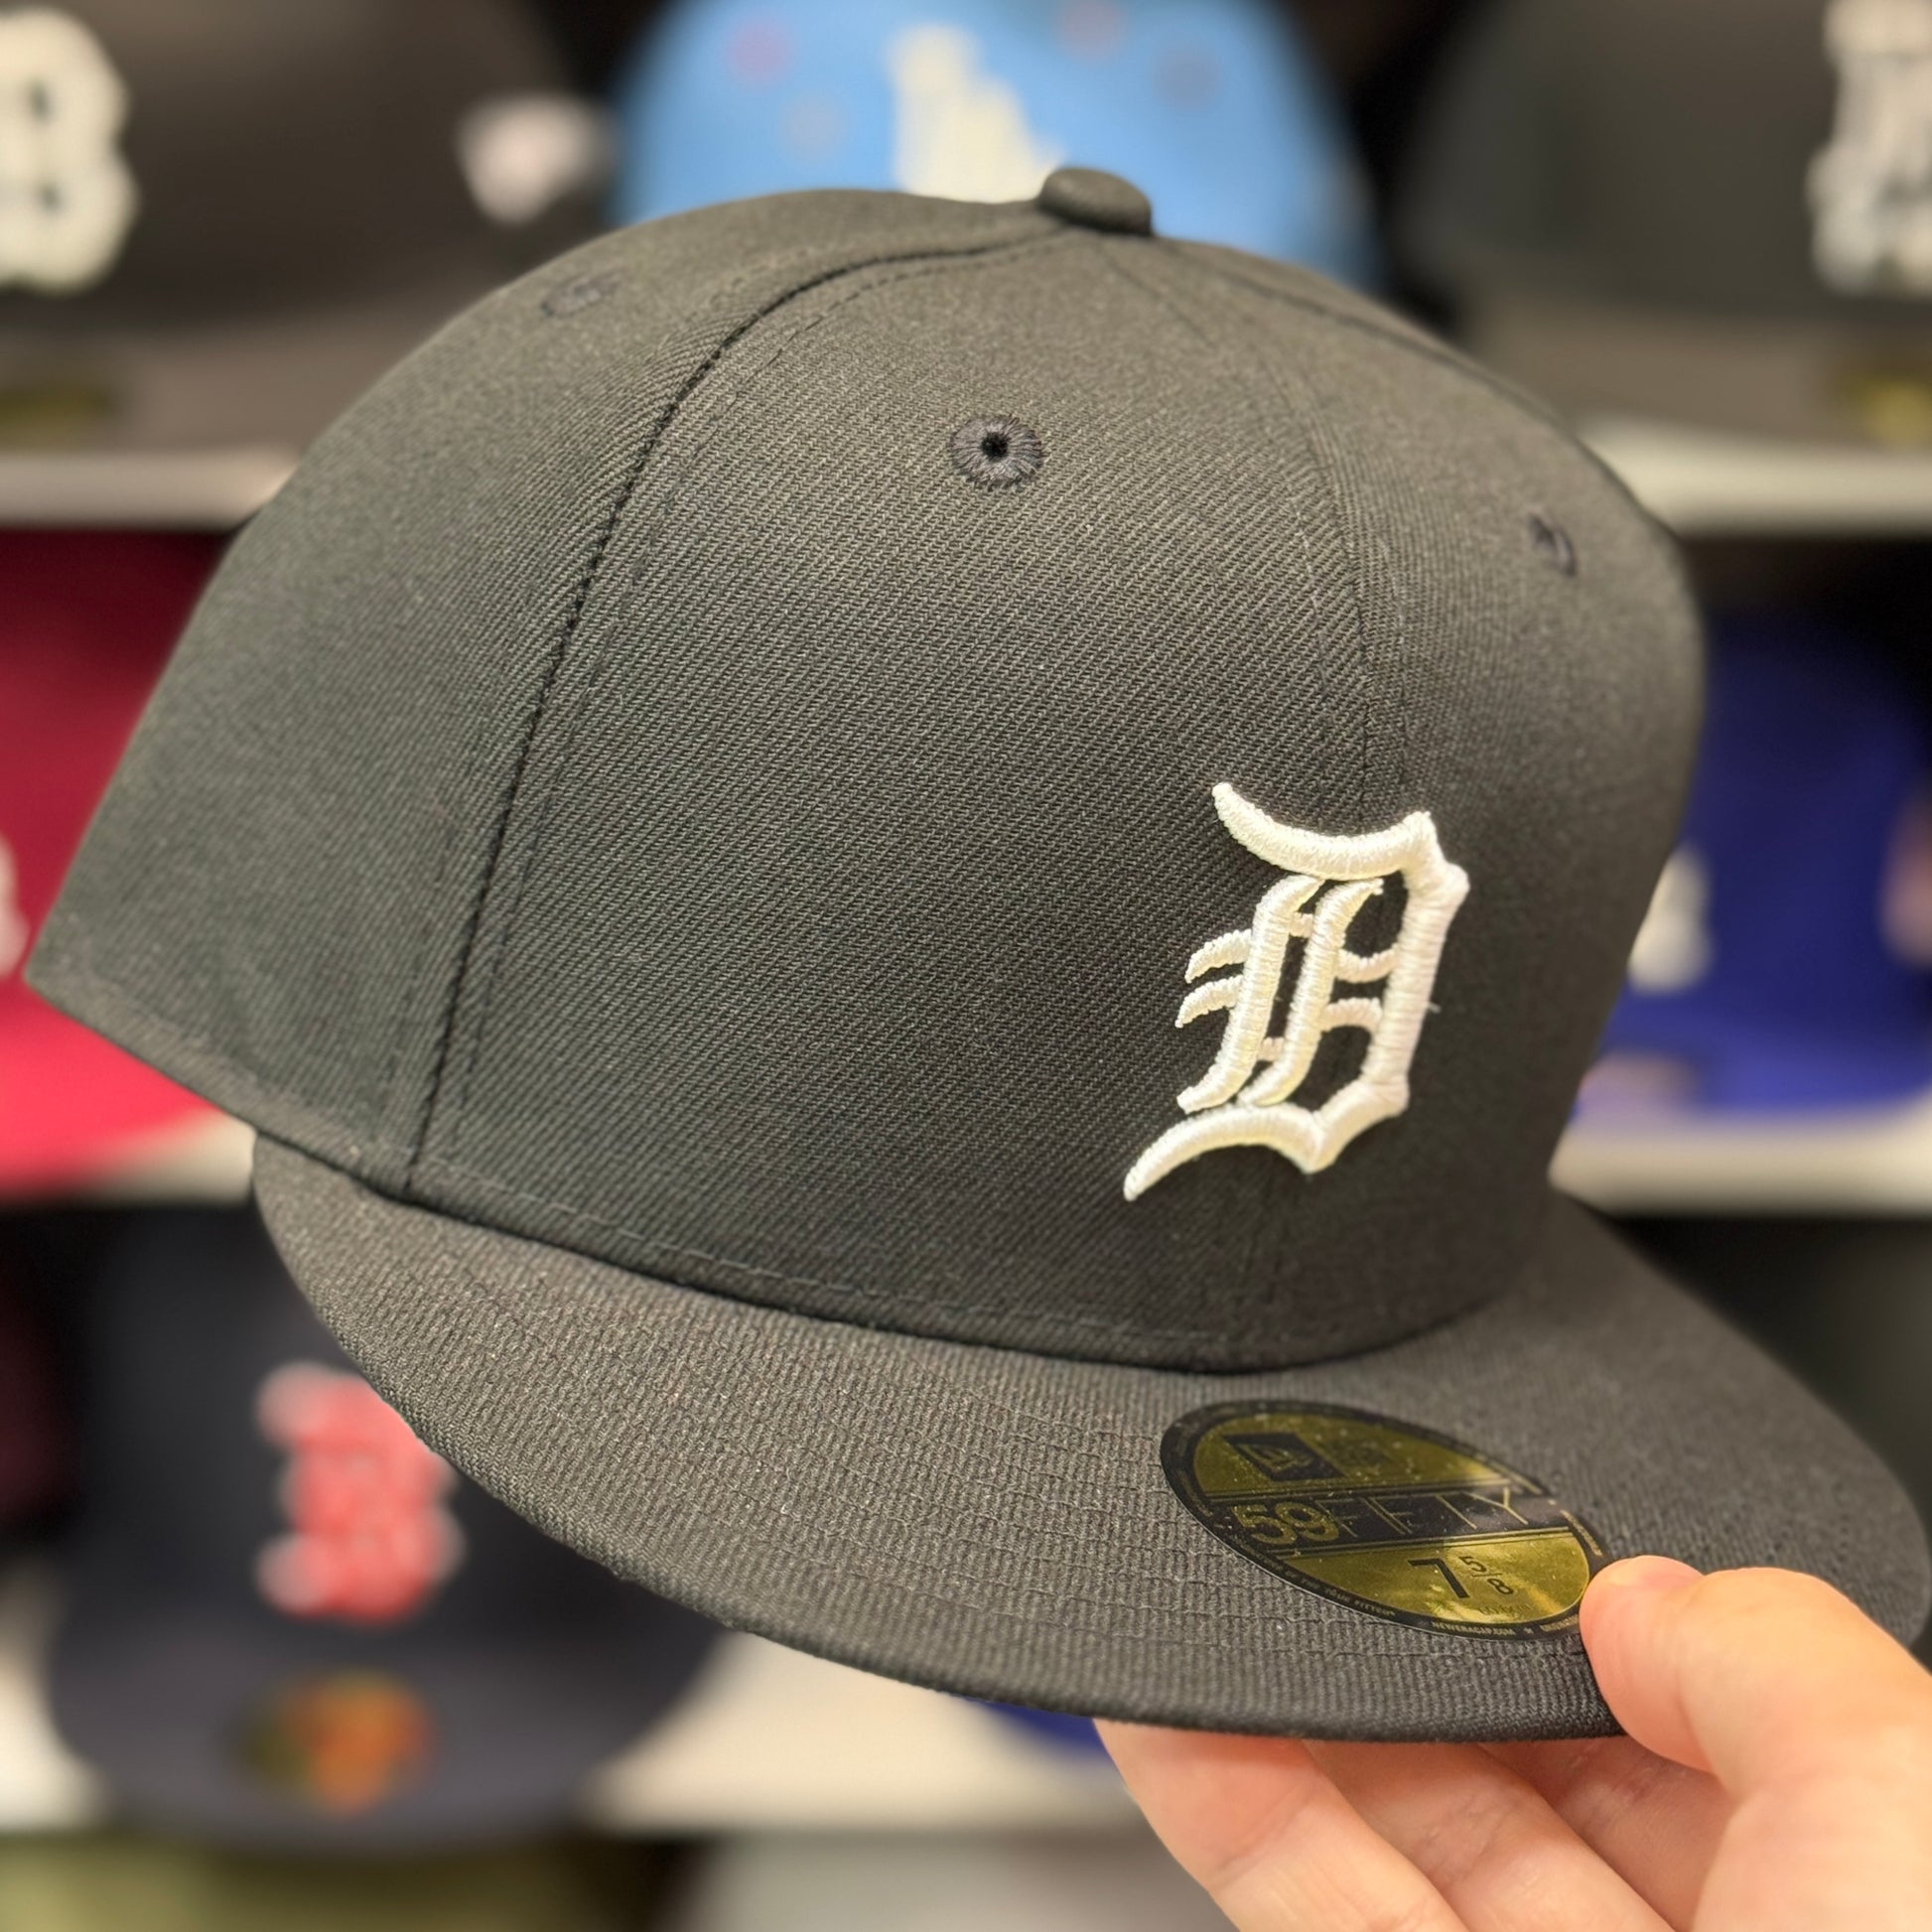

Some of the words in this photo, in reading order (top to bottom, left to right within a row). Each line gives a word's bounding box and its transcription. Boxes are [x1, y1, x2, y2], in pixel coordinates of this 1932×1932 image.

[1124, 781, 1469, 1201] D
[1230, 1486, 1529, 1545] 59FIFTY
[1408, 1557, 1470, 1598] 7
